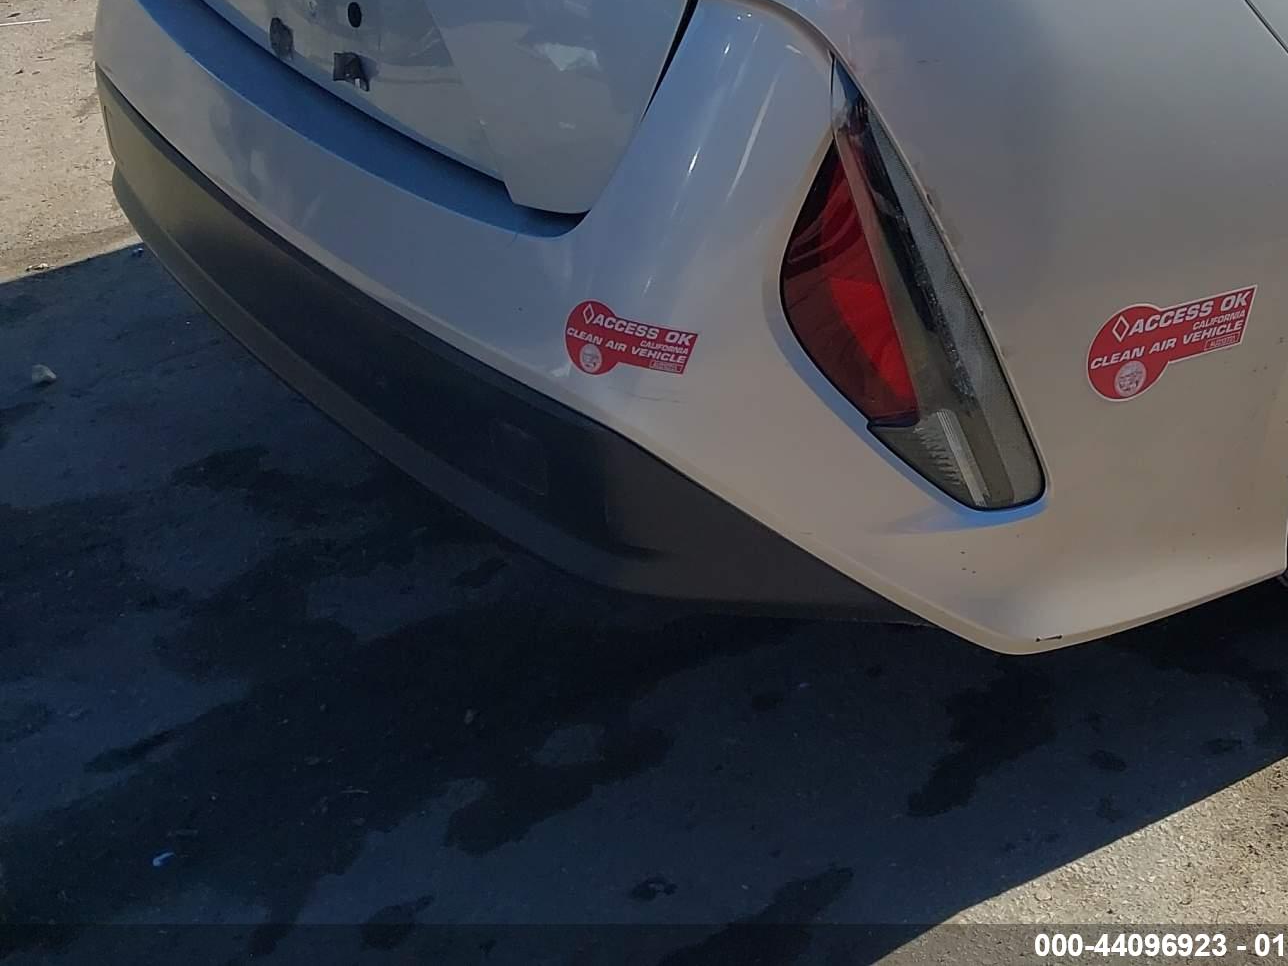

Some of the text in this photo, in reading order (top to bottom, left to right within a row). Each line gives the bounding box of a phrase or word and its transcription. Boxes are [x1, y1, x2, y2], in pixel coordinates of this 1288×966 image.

[593, 313, 694, 346] ACCESS OK
[1127, 291, 1250, 337] ACCESS OK
[1192, 309, 1246, 331] CALIFORNIA
[566, 327, 688, 364] CLEAN AIR VEHICLE
[640, 340, 689, 355] CALIFORNIA
[1090, 345, 1145, 370] CLEAN
[1149, 338, 1177, 355] AIR
[1183, 320, 1244, 345] VEHICLE
